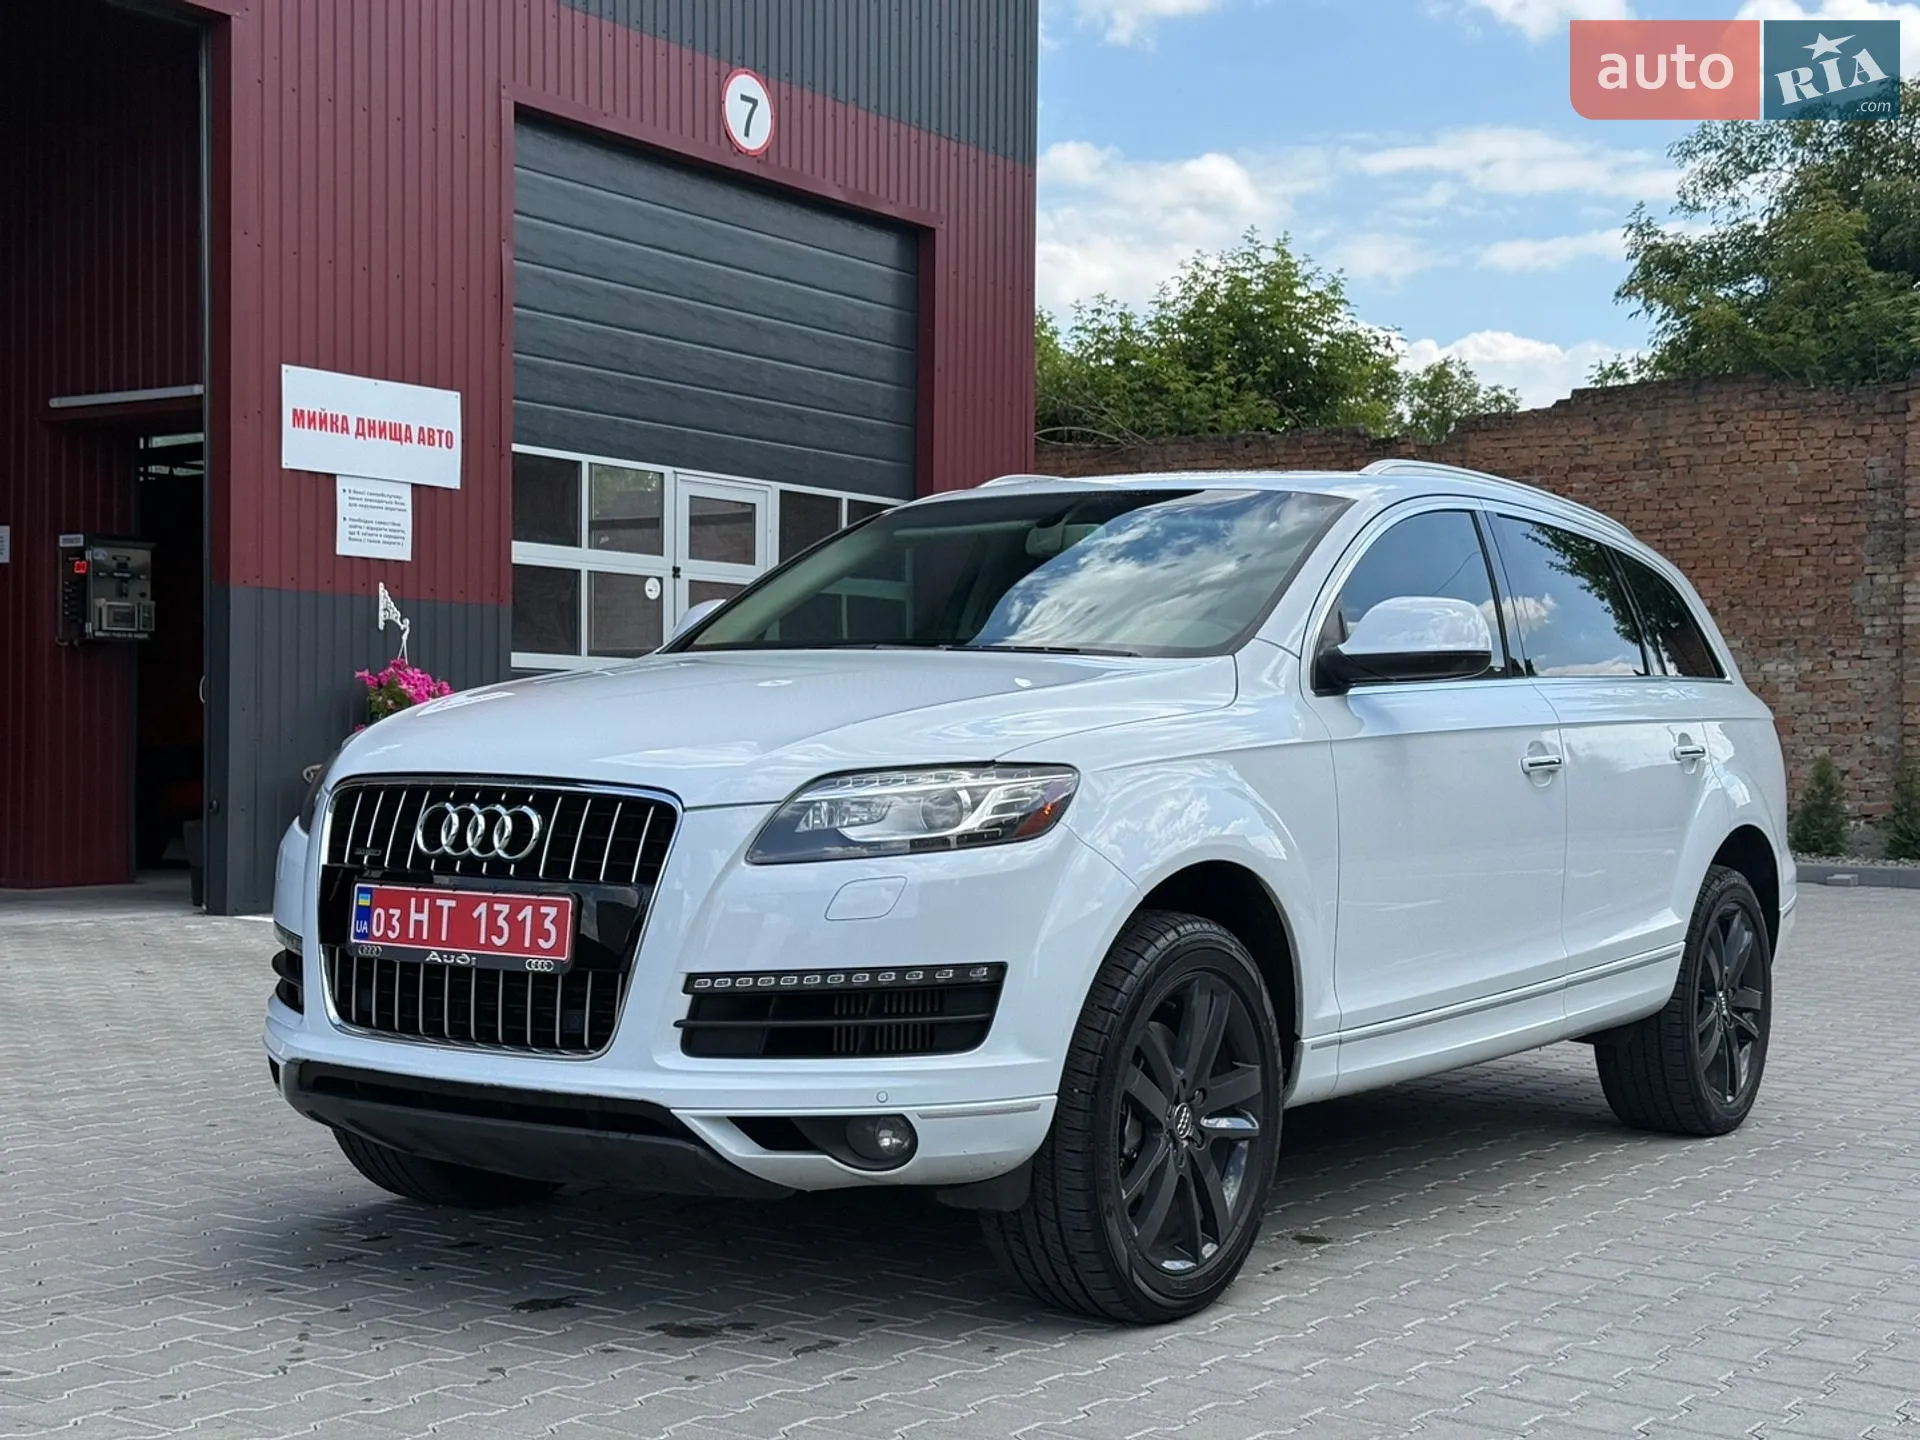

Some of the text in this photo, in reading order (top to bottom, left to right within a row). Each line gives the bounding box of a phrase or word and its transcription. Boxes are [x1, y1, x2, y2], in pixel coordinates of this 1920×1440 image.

[740, 93, 758, 138] 7
[291, 407, 454, 450] МИЙКА ДНИЩА АВТО
[355, 920, 369, 934] UA
[471, 901, 558, 950] 1313
[425, 951, 477, 966] Audi
